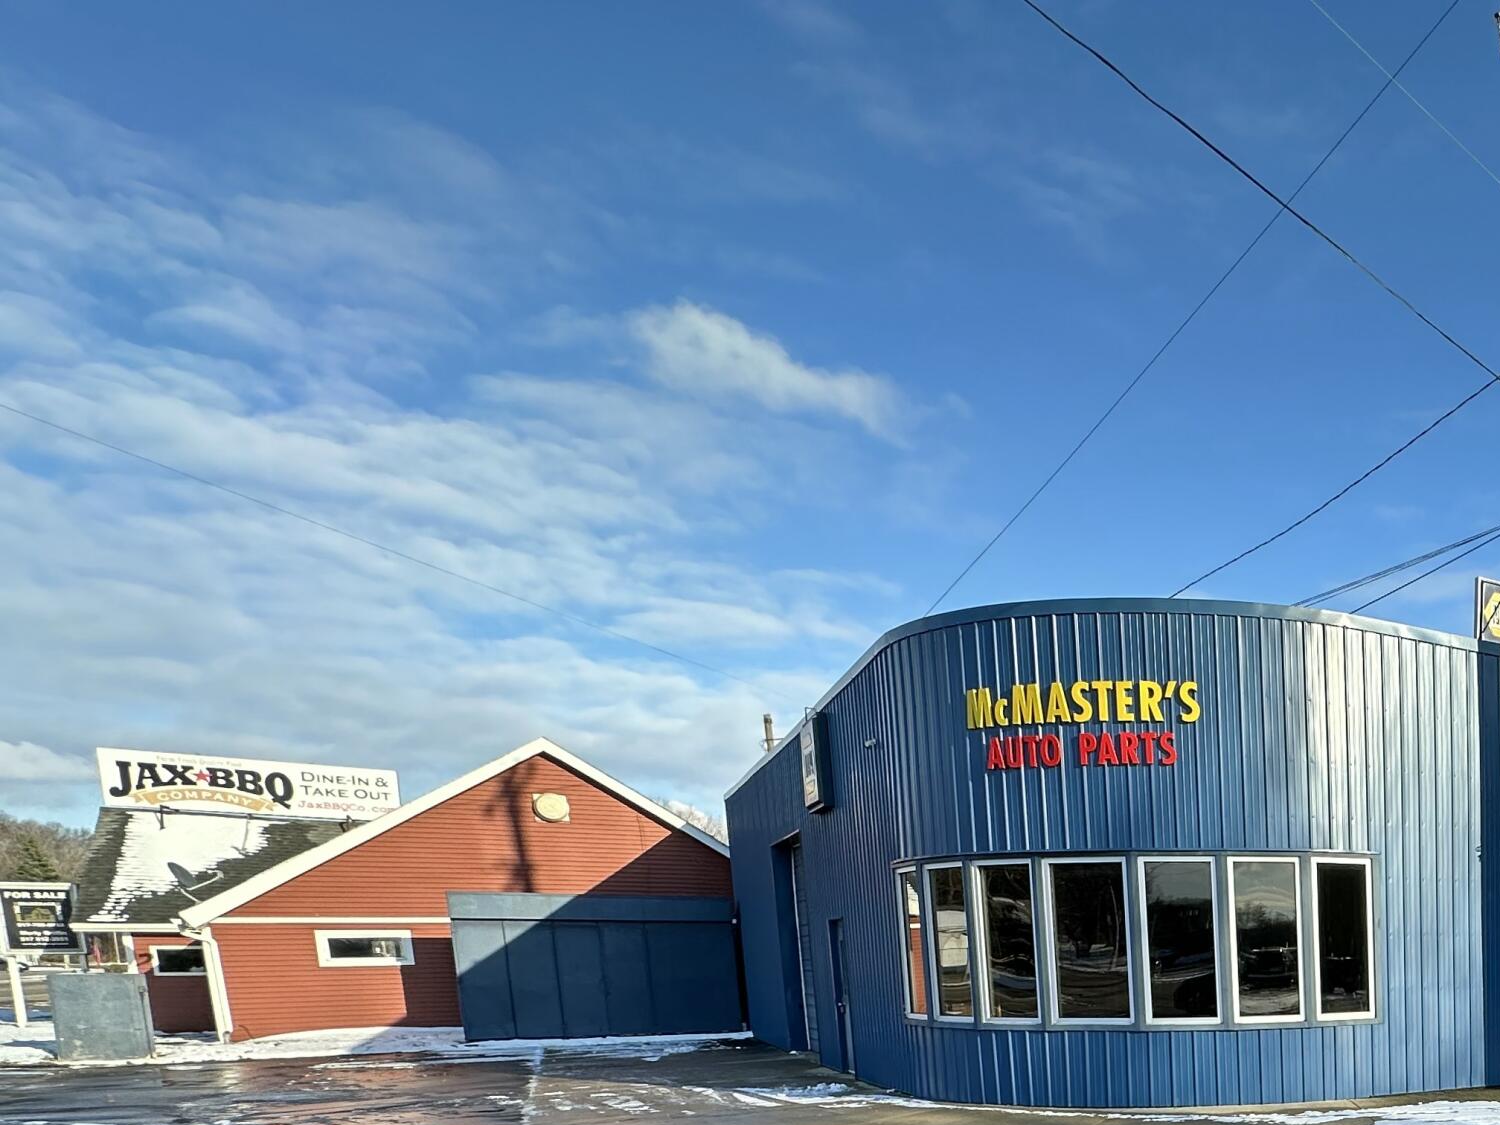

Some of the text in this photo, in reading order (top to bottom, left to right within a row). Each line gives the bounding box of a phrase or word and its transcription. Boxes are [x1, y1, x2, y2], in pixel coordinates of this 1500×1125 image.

[966, 680, 1201, 729] McMASTER'S
[987, 731, 1178, 770] AUTO PARTS
[109, 760, 294, 810] JAX BBQ
[375, 777, 389, 788] &
[156, 790, 254, 806] COMPANY
[353, 788, 391, 801] OUT
[3, 891, 67, 899] FOR SALE
